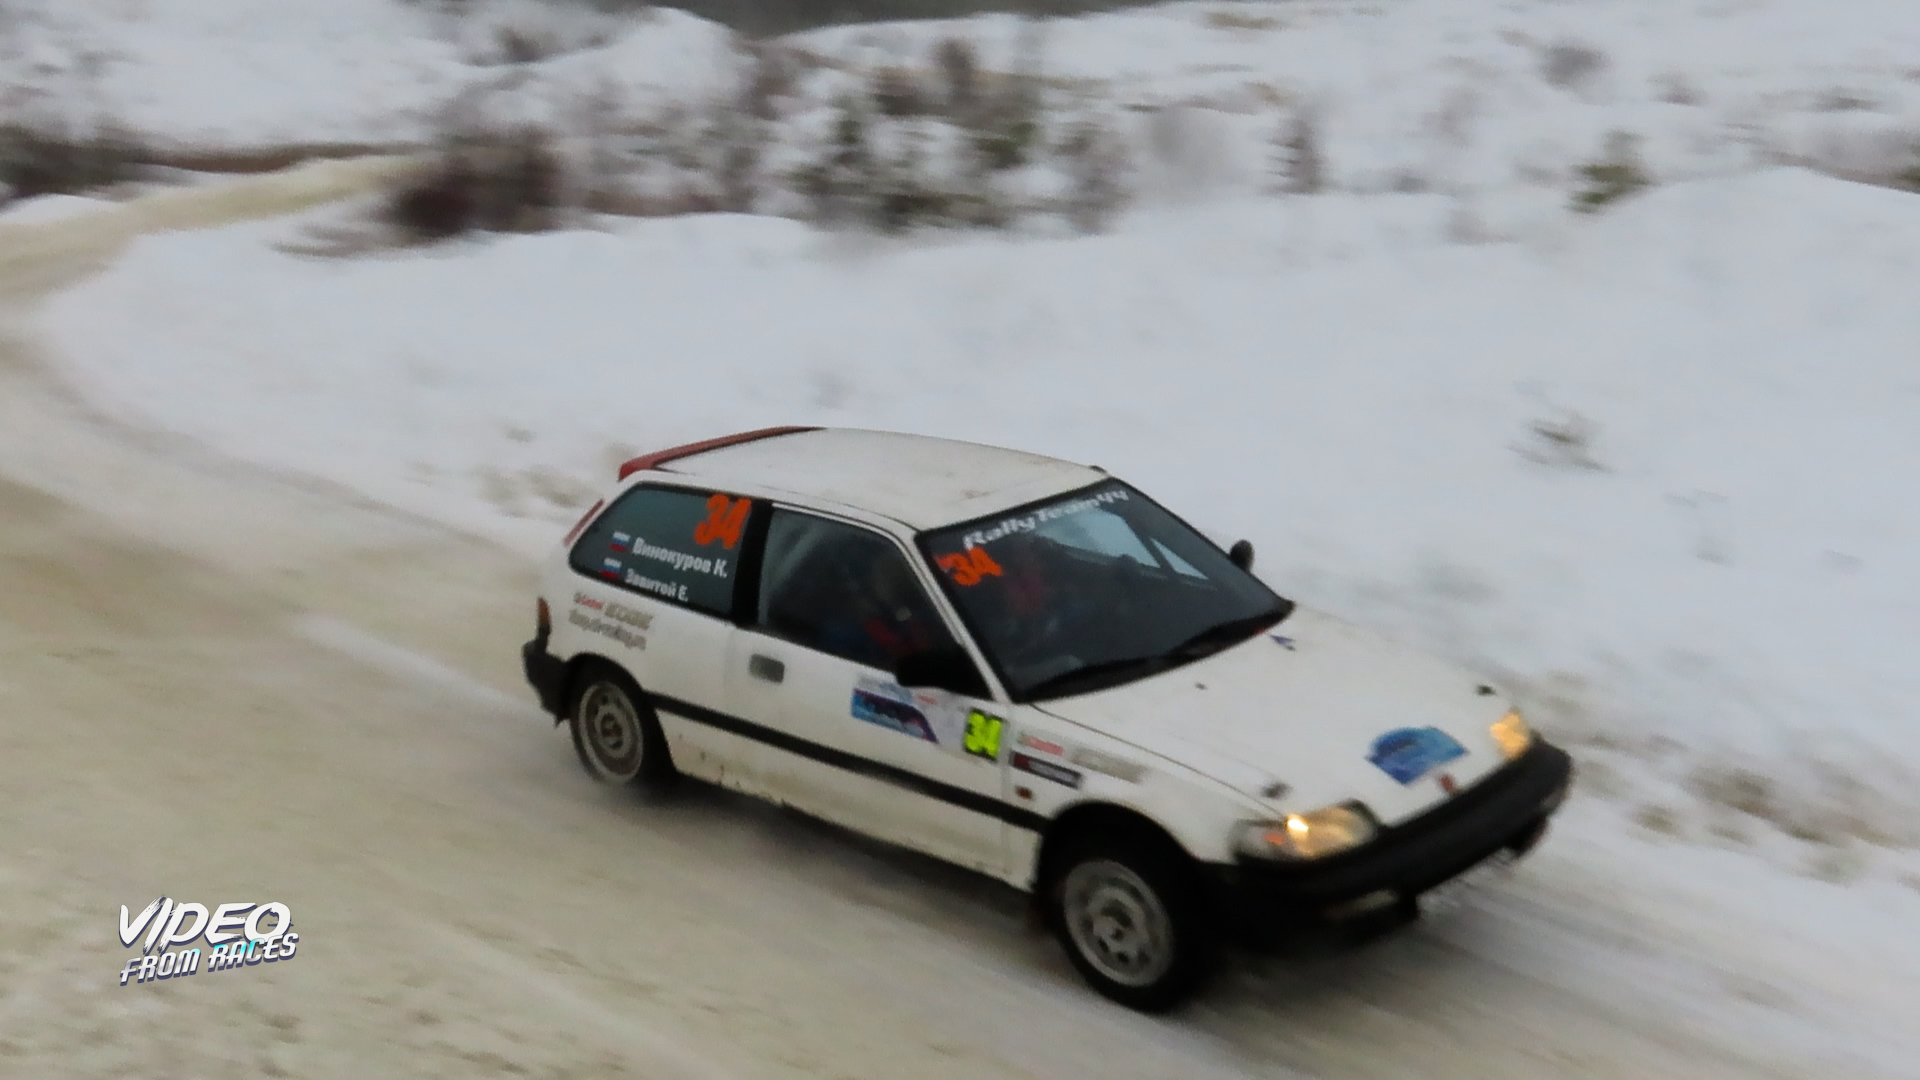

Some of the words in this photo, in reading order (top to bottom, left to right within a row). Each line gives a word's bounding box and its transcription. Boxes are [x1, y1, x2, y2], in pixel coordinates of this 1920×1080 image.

[694, 494, 752, 549] 34
[632, 536, 712, 574] Винокуров
[713, 558, 729, 579] К.
[936, 546, 1004, 586] 34
[624, 567, 677, 597] Завитой
[678, 585, 689, 602] Е.
[964, 710, 1002, 759] 34
